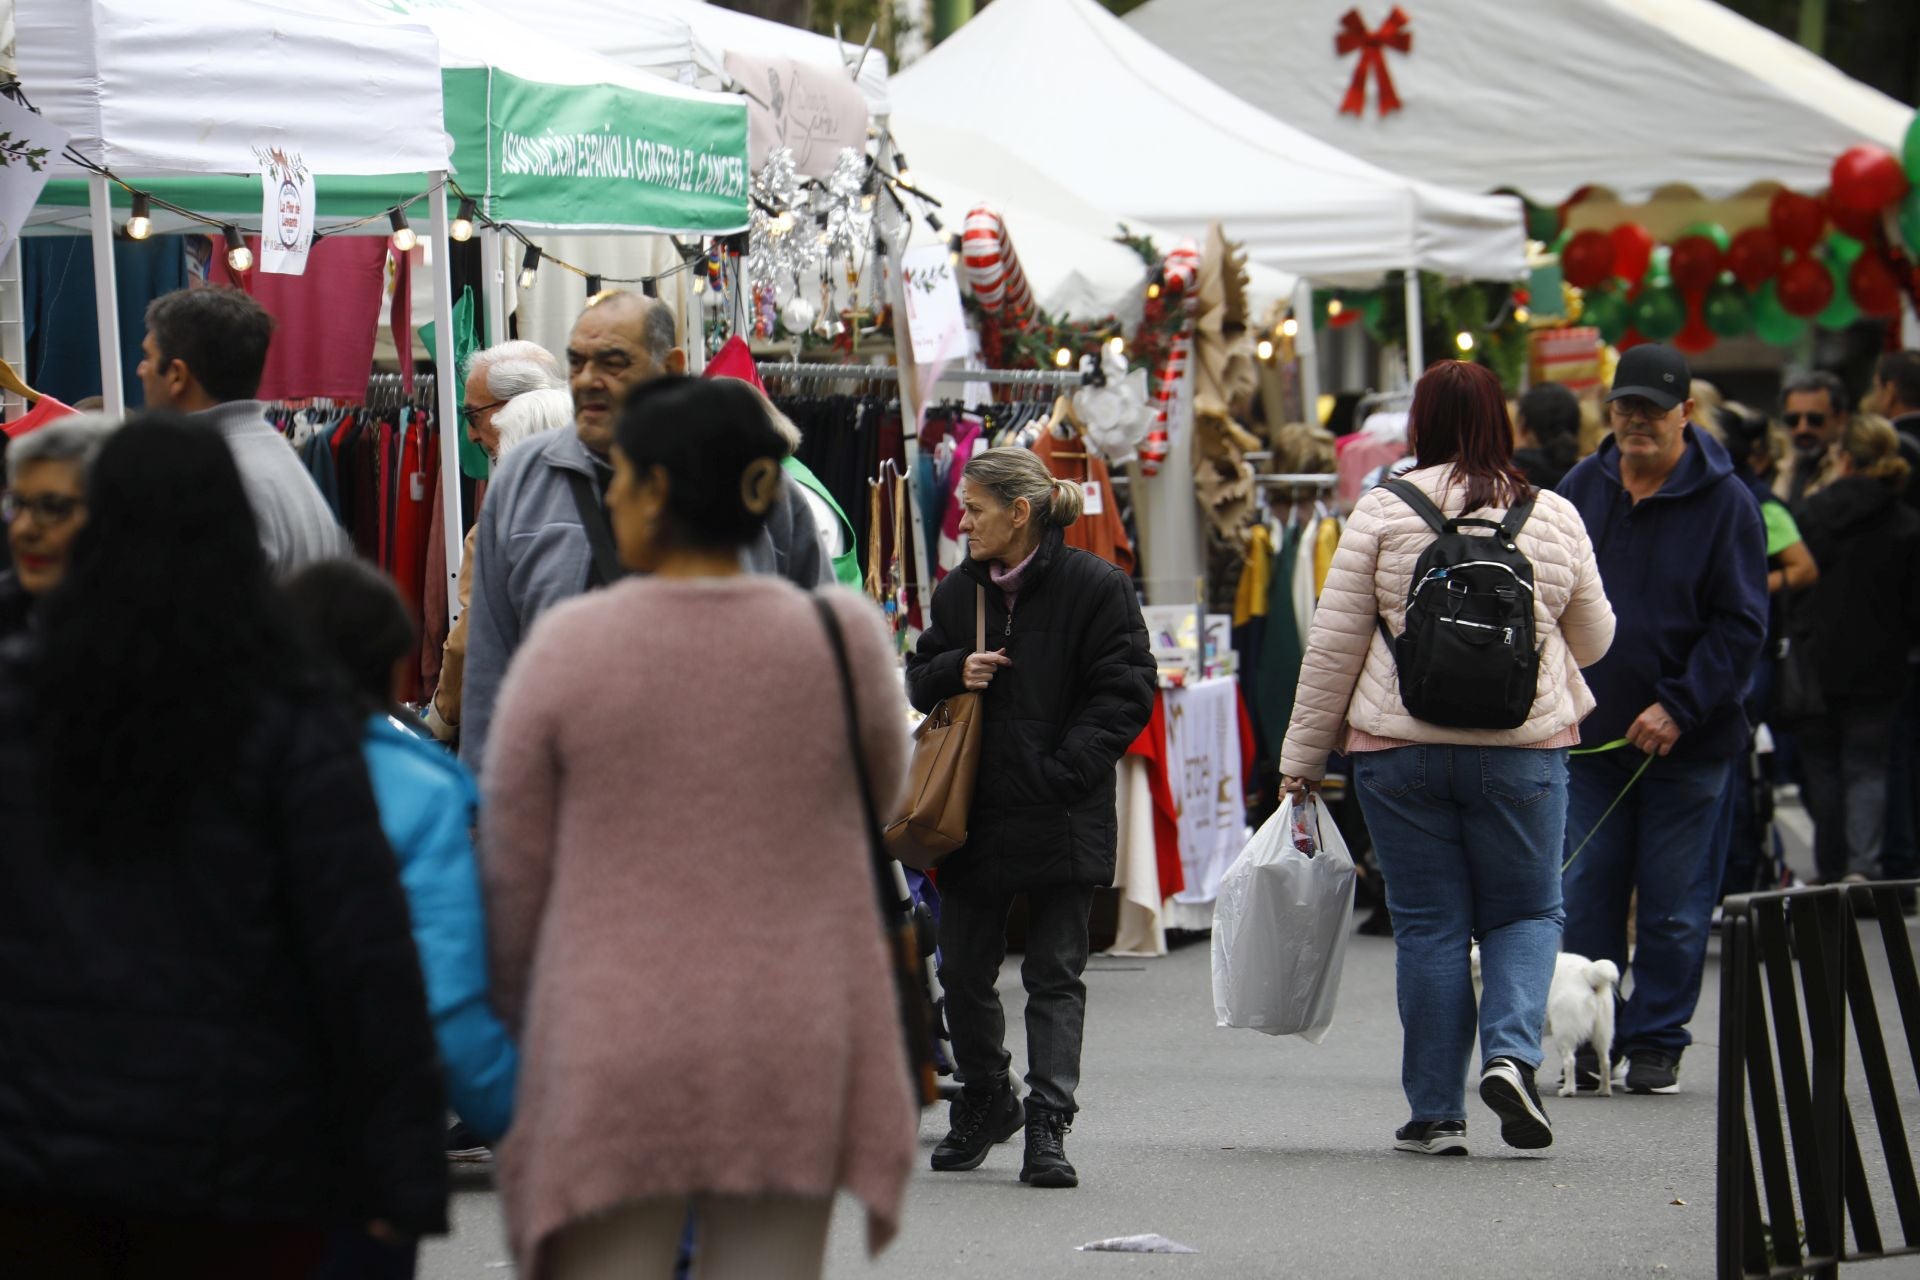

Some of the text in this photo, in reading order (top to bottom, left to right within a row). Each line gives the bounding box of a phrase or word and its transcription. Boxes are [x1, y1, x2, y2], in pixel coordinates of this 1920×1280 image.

[577, 123, 634, 178] ESPAÑOLA
[635, 138, 680, 188] CONTRA
[680, 148, 694, 191] EL
[695, 143, 742, 198] CÁNCER
